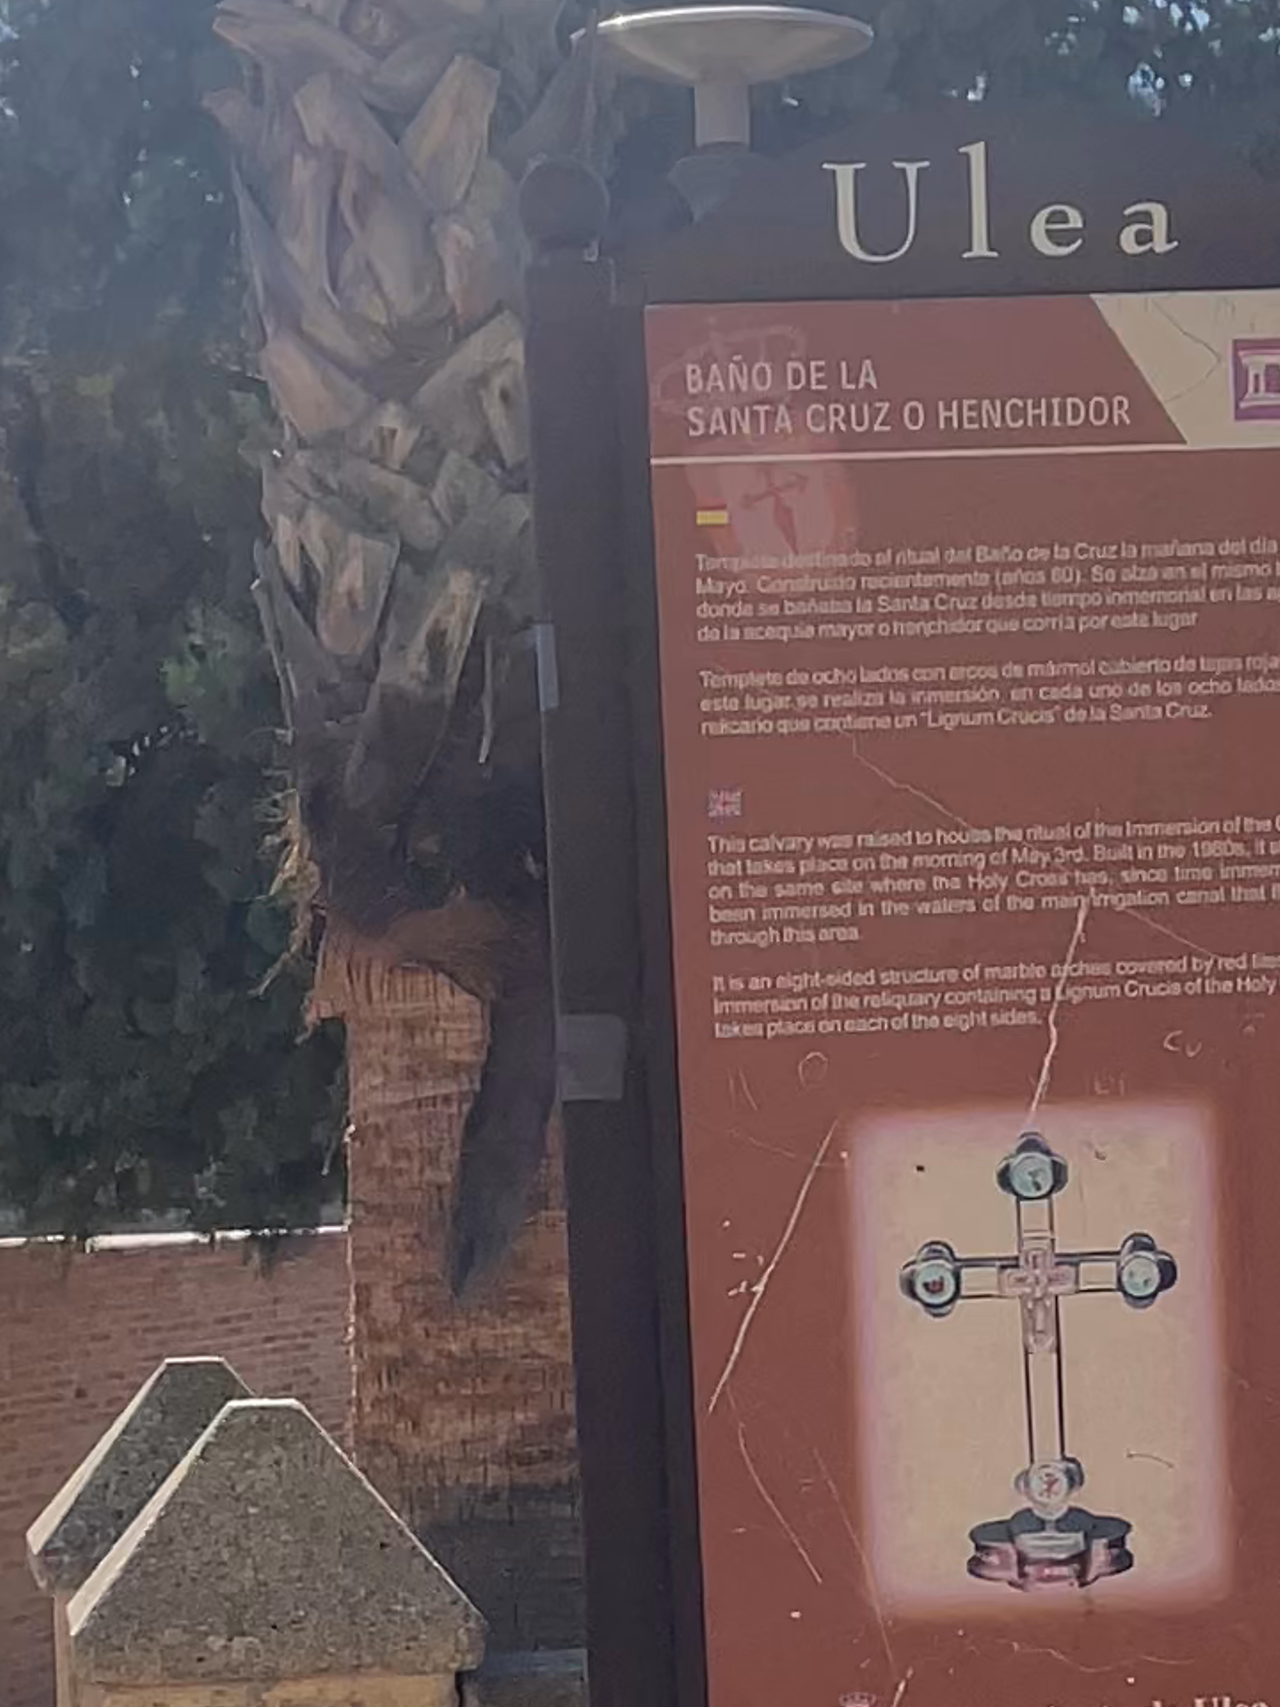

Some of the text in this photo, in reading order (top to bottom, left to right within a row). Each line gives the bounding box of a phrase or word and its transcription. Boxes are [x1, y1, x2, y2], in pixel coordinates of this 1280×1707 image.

[821, 141, 1179, 262] Ulea
[685, 355, 878, 394] BAÑO DE LA
[687, 395, 1131, 437] SANTA CRUZ O HENCHIDOR
[1053, 543, 1069, 560] la
[1074, 541, 1117, 559] Cruz
[1121, 541, 1136, 558] la
[1218, 537, 1246, 554] del
[856, 596, 872, 613] la
[934, 593, 977, 610] Cruz
[697, 625, 719, 642] de
[723, 624, 739, 641] la
[818, 623, 874, 642] mayor
[878, 622, 889, 636] o
[1078, 615, 1108, 633] por
[786, 668, 808, 685] de
[812, 667, 856, 684] ocho
[860, 665, 908, 683] lados
[913, 667, 944, 681] con
[1174, 655, 1195, 672] de
[890, 688, 904, 705] la
[1039, 682, 1082, 700] cada
[1089, 684, 1122, 698] uno
[1128, 680, 1150, 697] de
[1188, 677, 1232, 694] ocho
[894, 715, 916, 728] un
[1064, 705, 1085, 722] de
[1090, 705, 1105, 721] la
[1109, 703, 1161, 720] Santa
[1165, 701, 1212, 719] Cruz.
[708, 836, 745, 853] This
[749, 833, 814, 855] calvary
[915, 830, 932, 845] to
[1074, 822, 1090, 839] of
[1222, 816, 1240, 833] of
[852, 857, 874, 870] on
[989, 848, 1008, 865] of
[1137, 842, 1151, 859] in
[1157, 841, 1185, 858] the
[708, 885, 731, 899] on
[968, 871, 1008, 893] Holy
[858, 899, 873, 916] in
[881, 898, 909, 915] the
[982, 894, 1000, 911] of
[729, 974, 742, 991] is
[748, 977, 770, 990] an
[962, 964, 978, 981] of
[1192, 954, 1214, 975] by
[1218, 953, 1247, 970] red
[811, 993, 827, 1010] of
[1184, 977, 1201, 994] of
[1205, 976, 1233, 993] the
[1237, 974, 1276, 996] Holy
[818, 1019, 841, 1032] on
[890, 1012, 908, 1029] of
[912, 1011, 938, 1028] the
